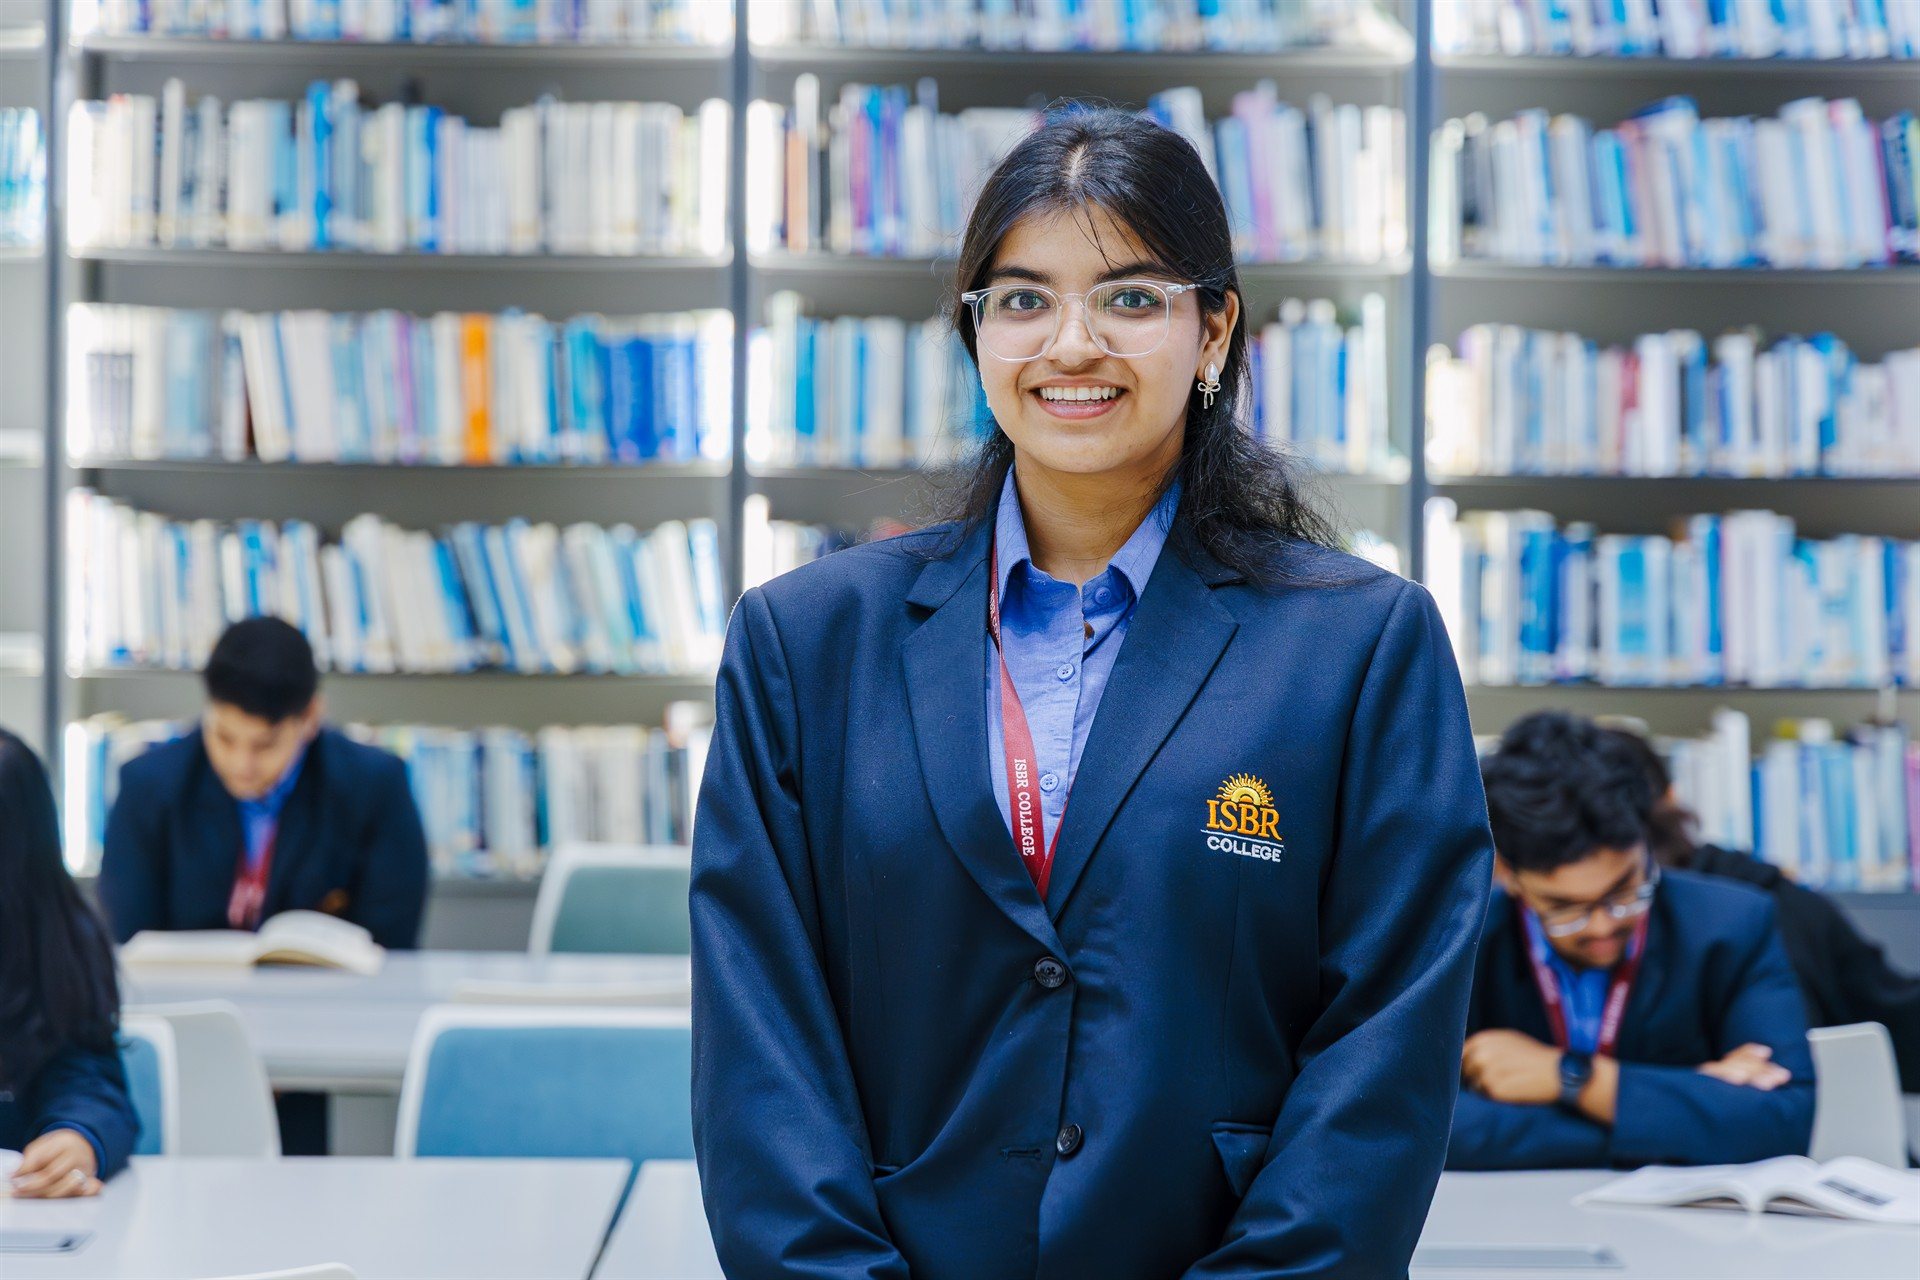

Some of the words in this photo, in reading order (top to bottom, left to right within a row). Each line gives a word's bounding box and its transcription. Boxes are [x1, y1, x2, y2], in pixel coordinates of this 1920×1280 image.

[1014, 758, 1029, 788] ISBR
[1018, 791, 1035, 856] COLLEGE
[1206, 799, 1282, 840] ISBR
[1206, 836, 1282, 862] COLLEGE
